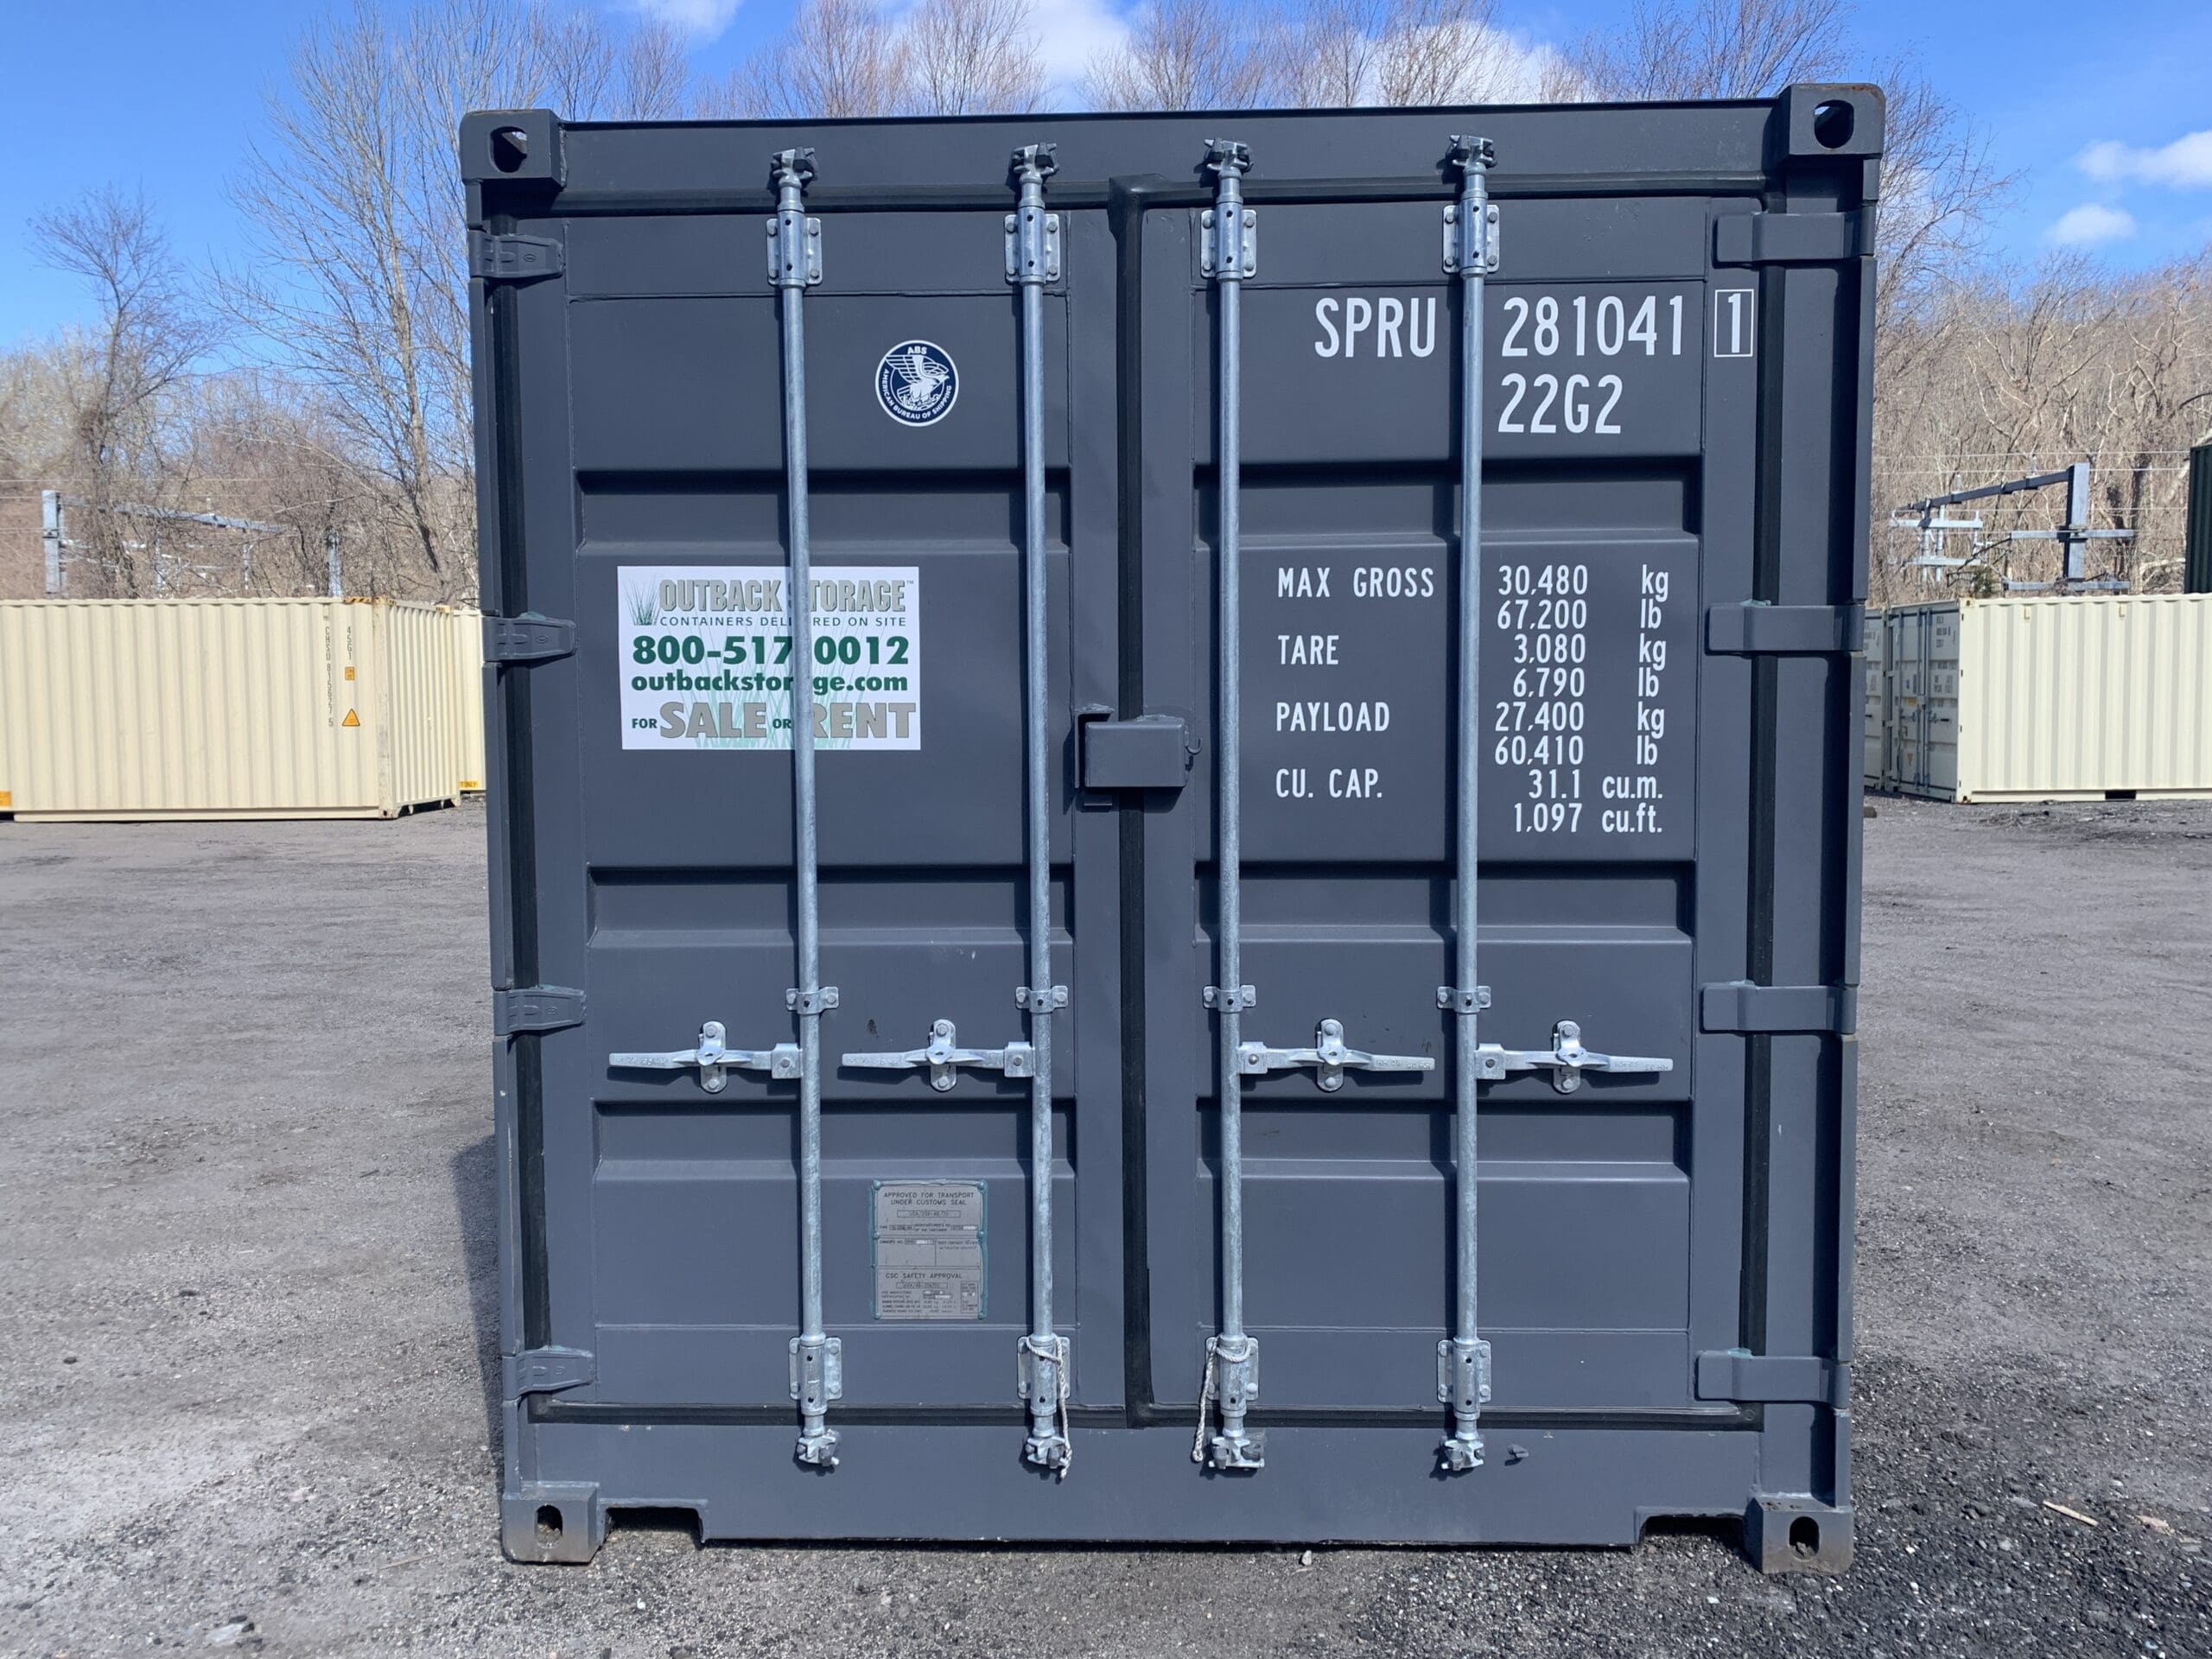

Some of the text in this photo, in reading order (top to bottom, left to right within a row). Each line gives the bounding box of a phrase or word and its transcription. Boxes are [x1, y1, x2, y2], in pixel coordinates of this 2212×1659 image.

[1314, 293, 1741, 358] SPRU 281041 1
[907, 346, 927, 354] ABS
[882, 369, 895, 406] AMERICAN
[893, 405, 920, 419] BUREAU
[932, 385, 952, 415] SHIPPING
[1497, 372, 1623, 435] 22G2
[659, 580, 782, 613] OUTBACK
[787, 580, 906, 613] TORAGE
[1278, 563, 1669, 602] MAX GROSS 30,480 kg
[660, 616, 906, 626] CONTAINERS DELIRED ON SITE
[1497, 599, 1662, 631] 67,200 lb
[632, 635, 909, 665] 800-5170012
[1277, 632, 1667, 671] TARE 3,080 kg
[632, 669, 908, 696] outbackstorge.com
[1513, 667, 1660, 698] 6,790 lb
[632, 701, 917, 739] FOR SALE OR RENT
[1276, 701, 1665, 739] PAYLOAD 27,400 kg
[1495, 734, 1658, 766] 60,410 lb
[1275, 768, 1663, 799] CU. CAP. 31.1 cu.m.
[1514, 802, 1662, 834] 1,097 cu.ft.
